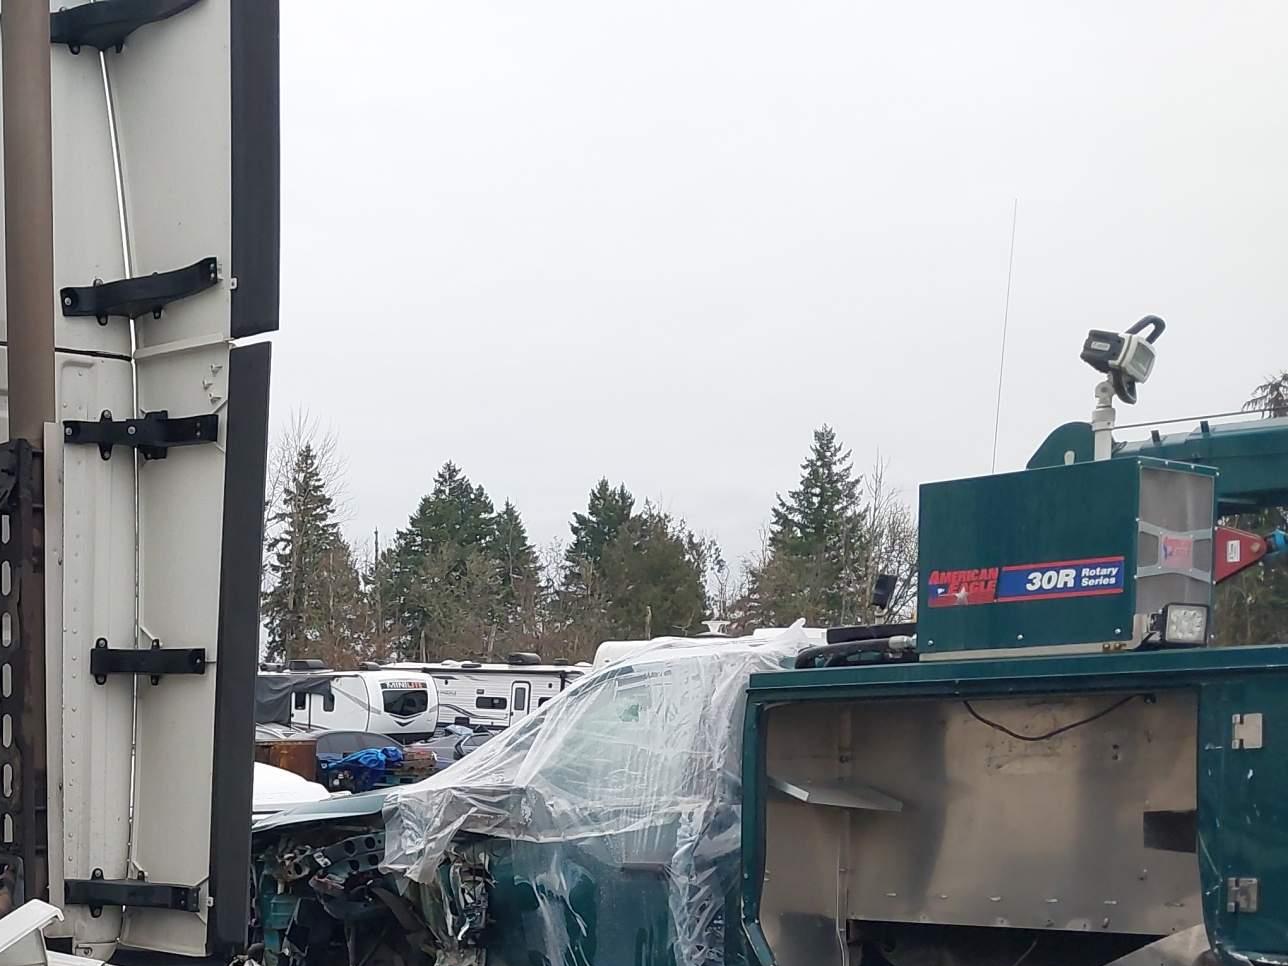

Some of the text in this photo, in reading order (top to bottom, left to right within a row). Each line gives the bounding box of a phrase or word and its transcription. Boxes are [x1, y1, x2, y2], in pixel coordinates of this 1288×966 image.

[928, 567, 999, 585] AMERICAN
[1081, 566, 1119, 577] Rotary
[948, 580, 997, 595] EAGLE
[1025, 569, 1076, 591] 30R
[1081, 576, 1116, 587] Series
